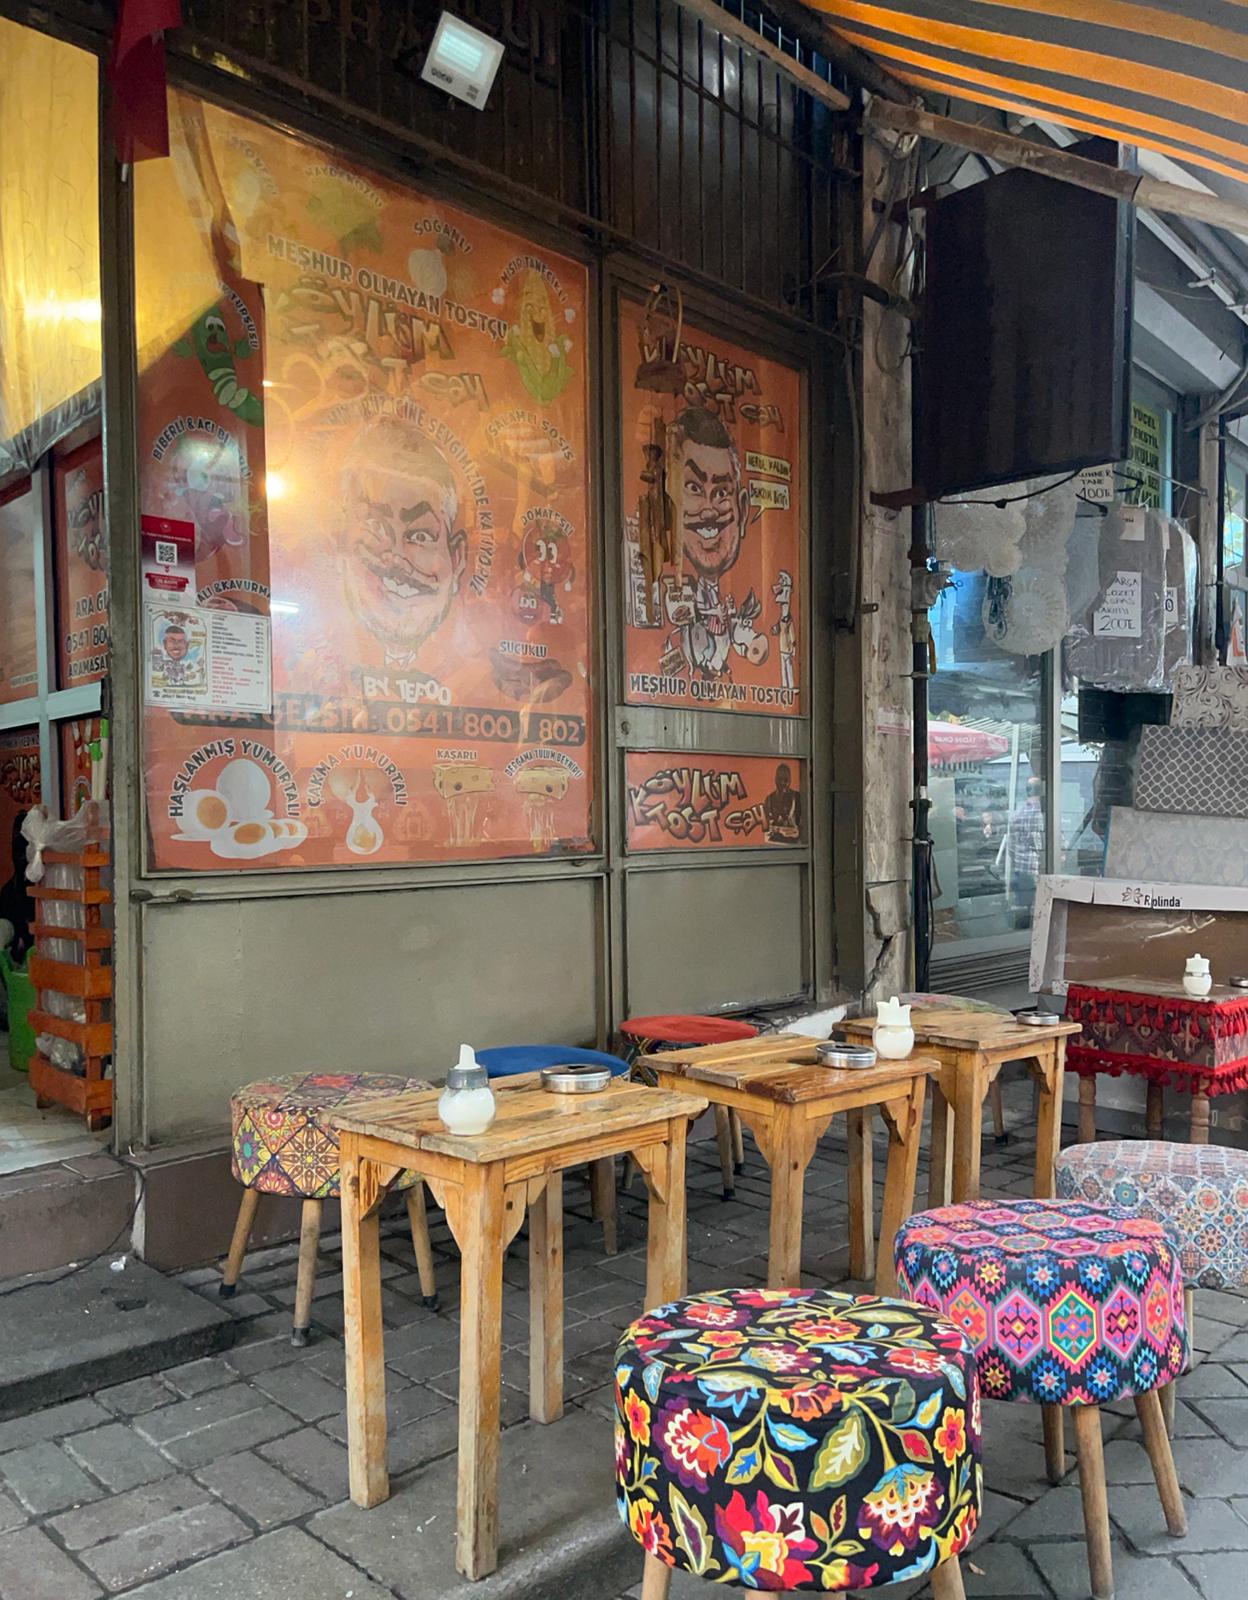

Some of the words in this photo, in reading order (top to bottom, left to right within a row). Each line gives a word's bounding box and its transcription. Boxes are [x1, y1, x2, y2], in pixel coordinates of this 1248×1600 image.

[267, 233, 354, 285] MEŞHUR
[357, 267, 442, 317] OLMAYAN
[443, 300, 509, 343] TOSTÇU
[187, 416, 196, 431] &
[197, 417, 216, 435] ACI
[76, 596, 95, 618] ARA
[498, 640, 549, 659] SUCUKLU
[363, 676, 390, 697] BY
[629, 673, 687, 699] MEŞHUR
[690, 680, 747, 702] OLMAYAN
[749, 686, 794, 708] TOSTÇU
[386, 705, 453, 735] 0541
[463, 713, 513, 739] 800
[539, 718, 580, 742] 802
[436, 749, 479, 762] KAŞARLI
[168, 738, 235, 818] HAŞLANMIŞ
[240, 740, 300, 819] YUMURTALI
[307, 753, 341, 808] ÇAKMA
[342, 744, 408, 807] YUMURTALI
